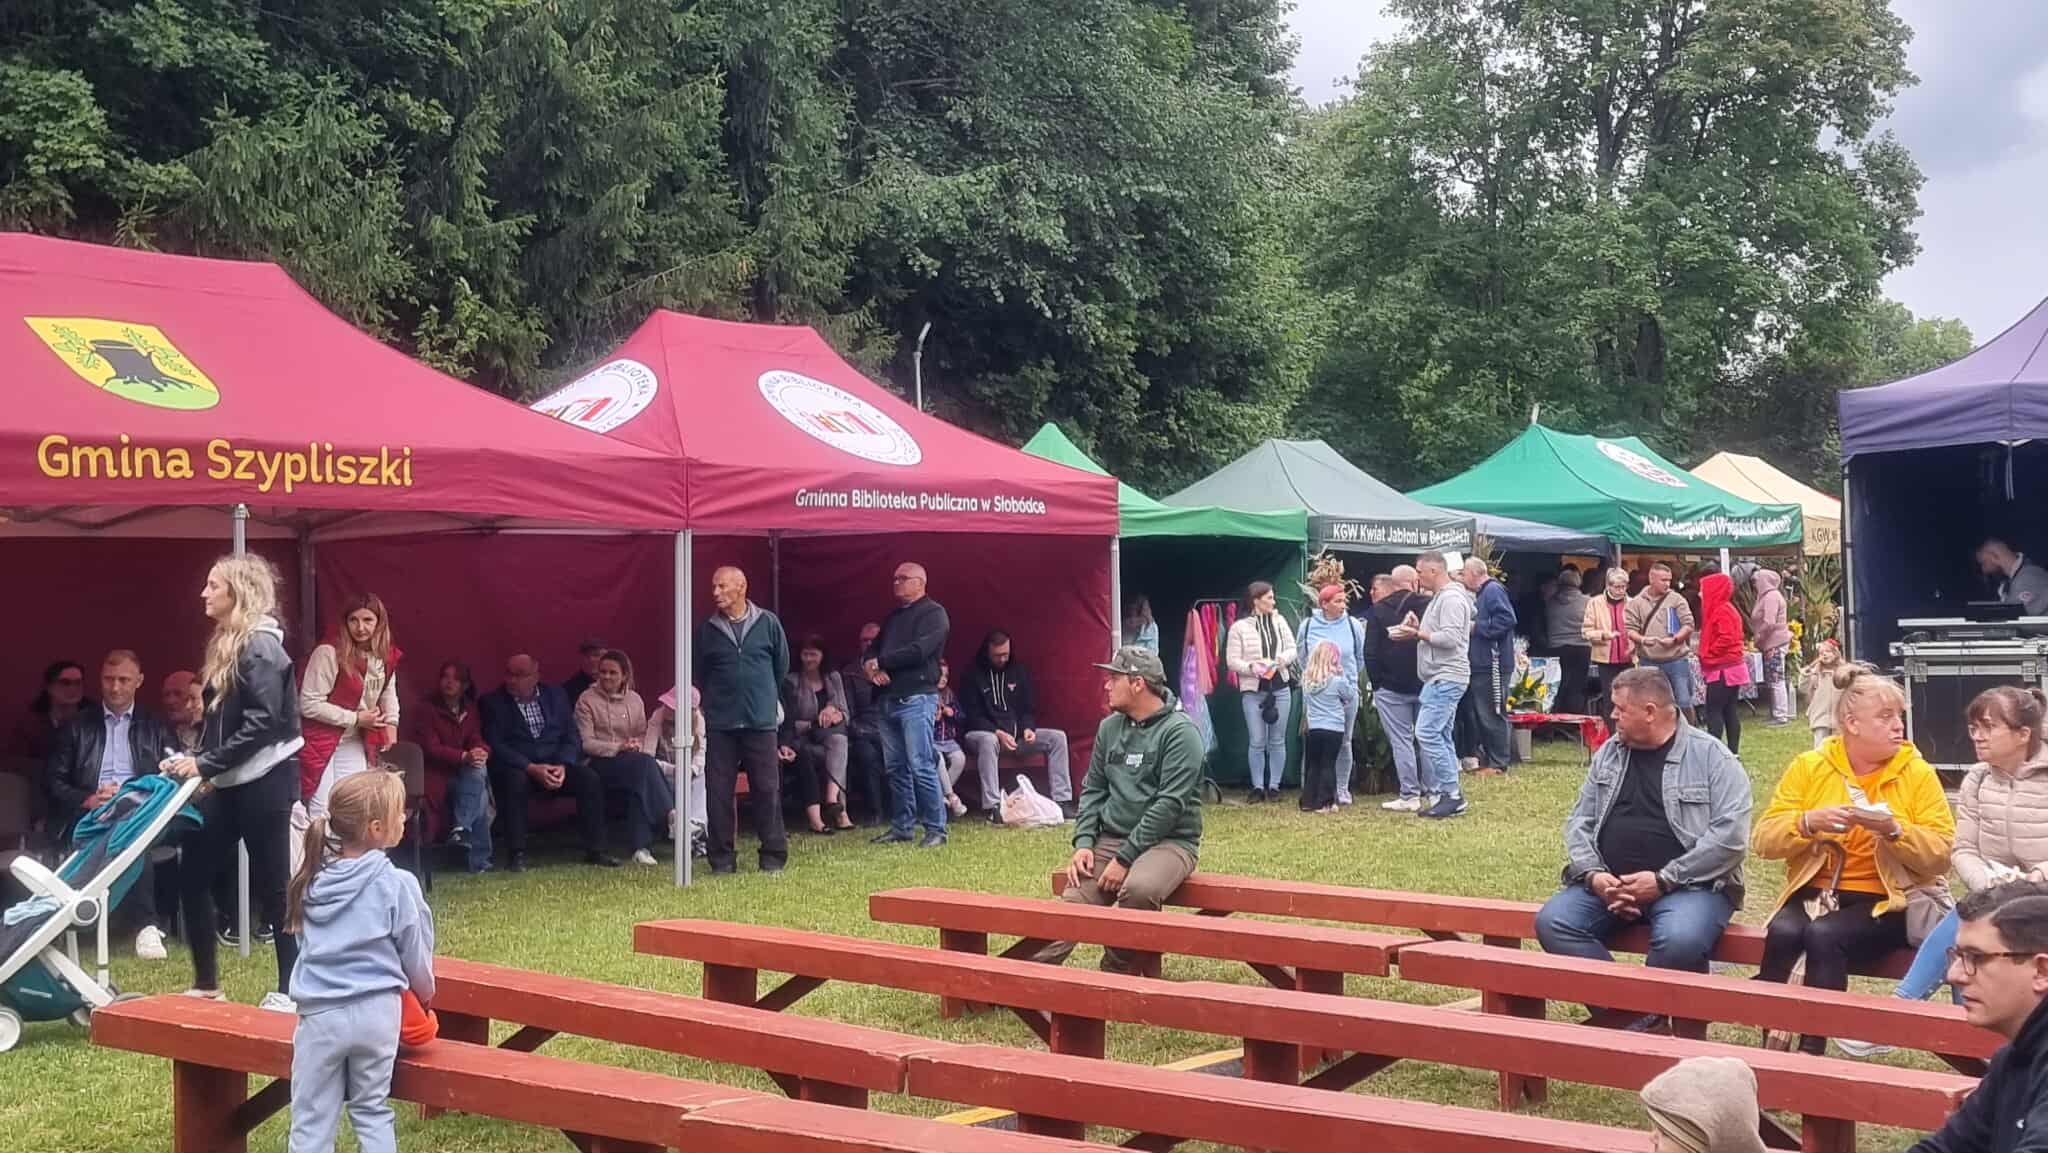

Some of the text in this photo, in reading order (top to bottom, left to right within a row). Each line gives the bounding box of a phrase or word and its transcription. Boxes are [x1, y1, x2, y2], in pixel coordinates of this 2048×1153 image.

[37, 433, 413, 493] Gmina Szypliszki
[795, 488, 1046, 514] Gminna Biblioteka Publiczna w Słobódce
[1333, 523, 1358, 539] KGW
[1360, 523, 1386, 542] Kwiat
[1420, 531, 1428, 544] w
